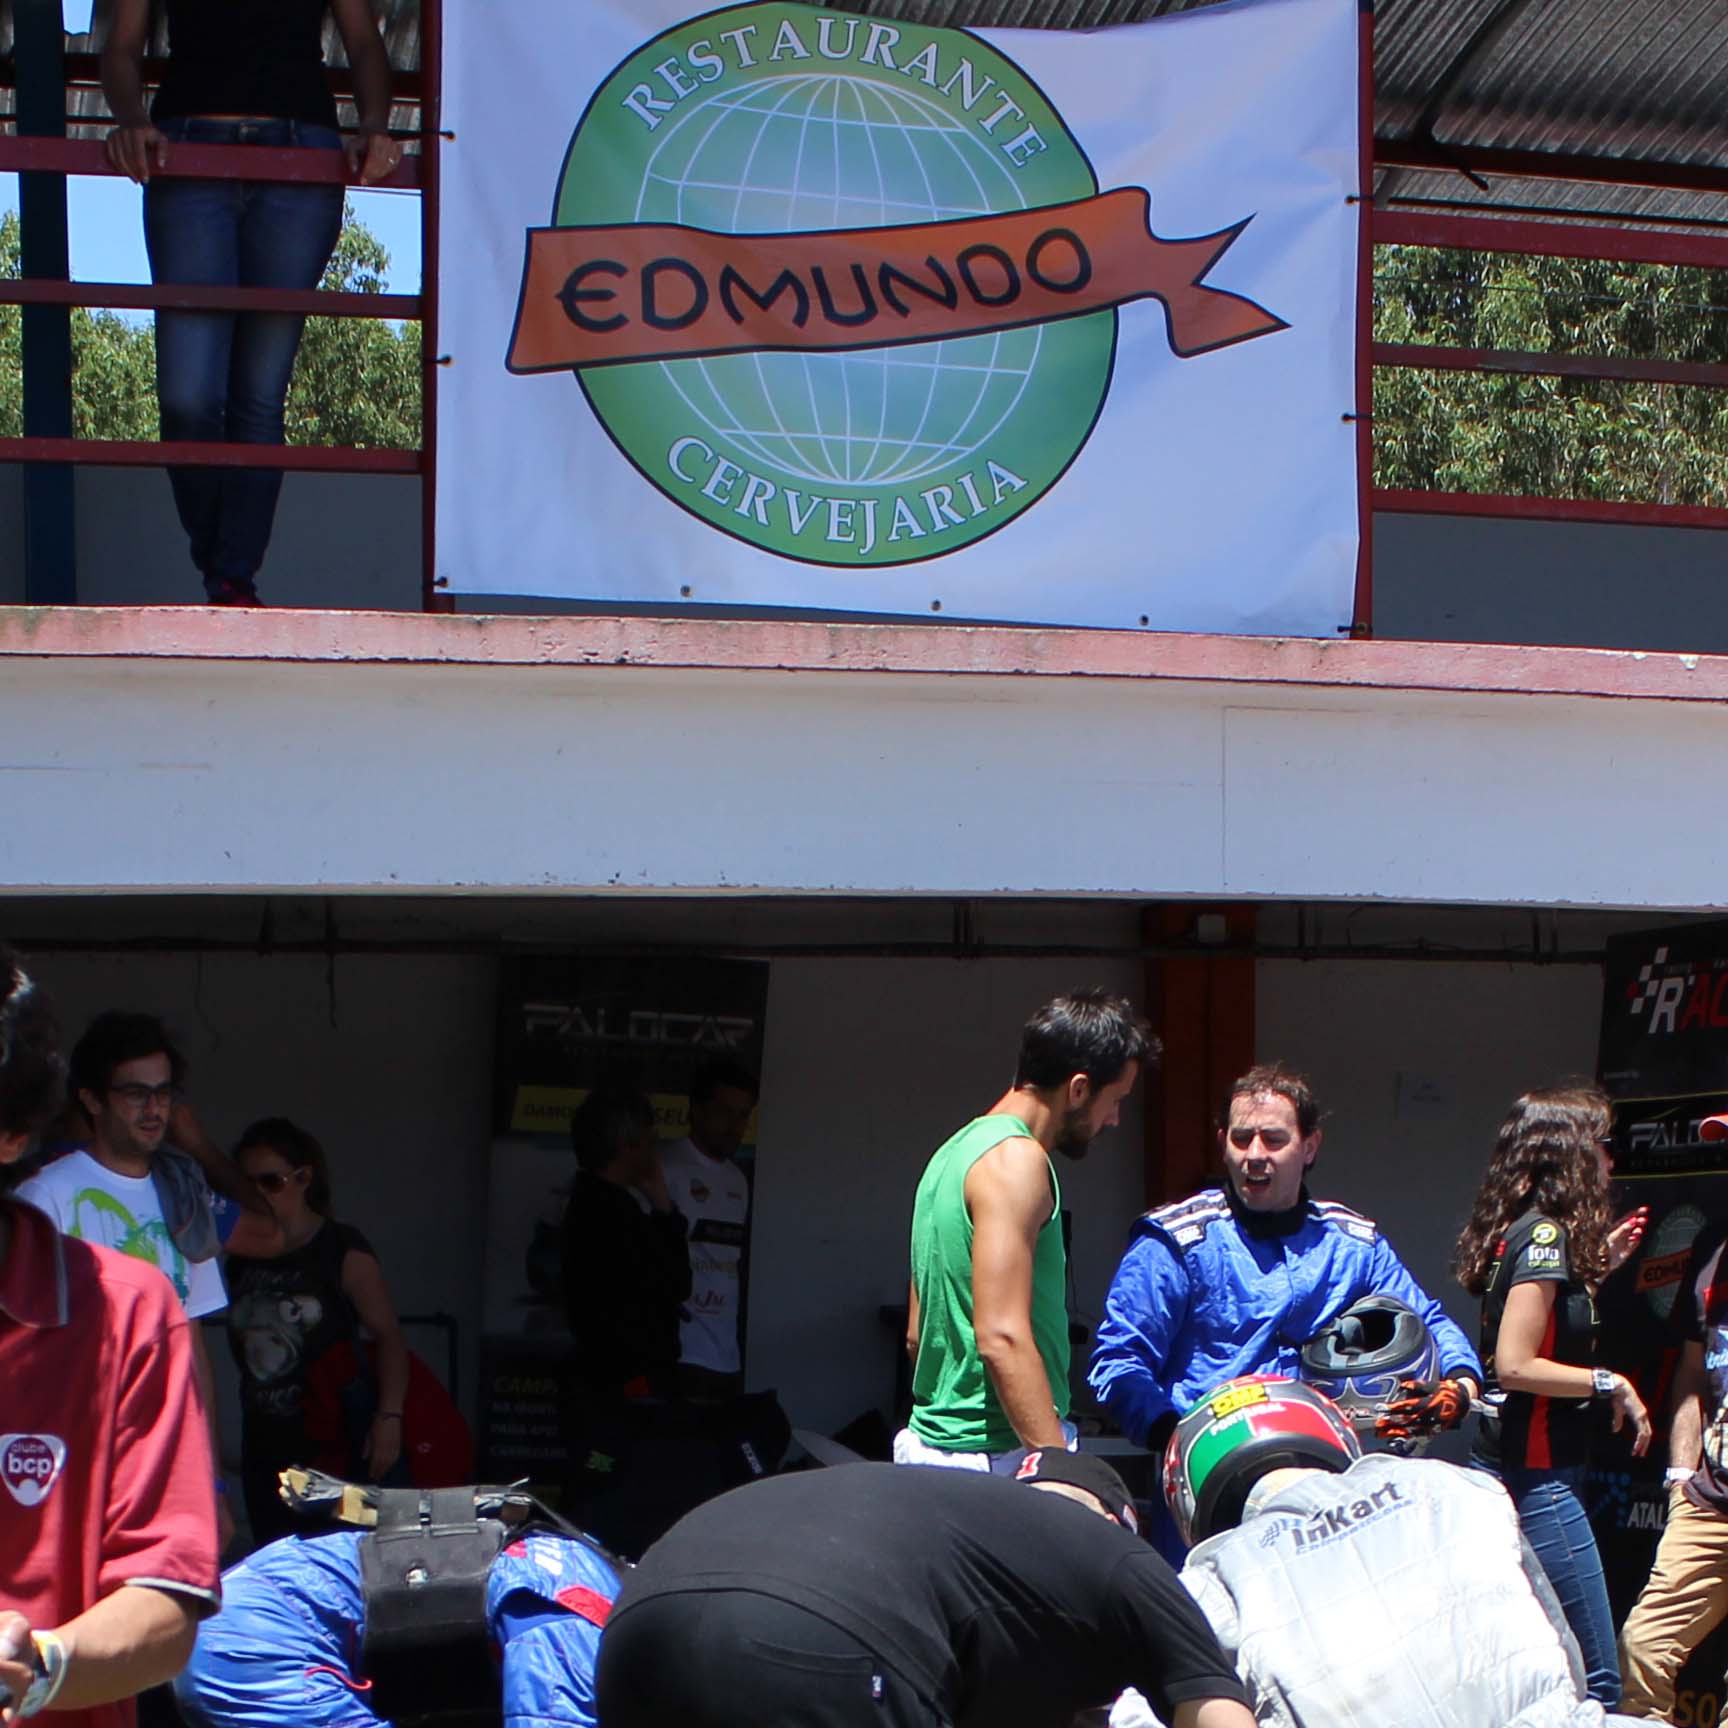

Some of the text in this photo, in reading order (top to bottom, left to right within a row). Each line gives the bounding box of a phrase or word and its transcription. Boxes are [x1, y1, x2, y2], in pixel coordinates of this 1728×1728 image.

[622, 18, 1047, 168] RESTAURANTE
[556, 226, 1092, 333] EDMUNDO
[666, 433, 1028, 555] CERVEJARIA
[7, 1452, 52, 1479] bcp
